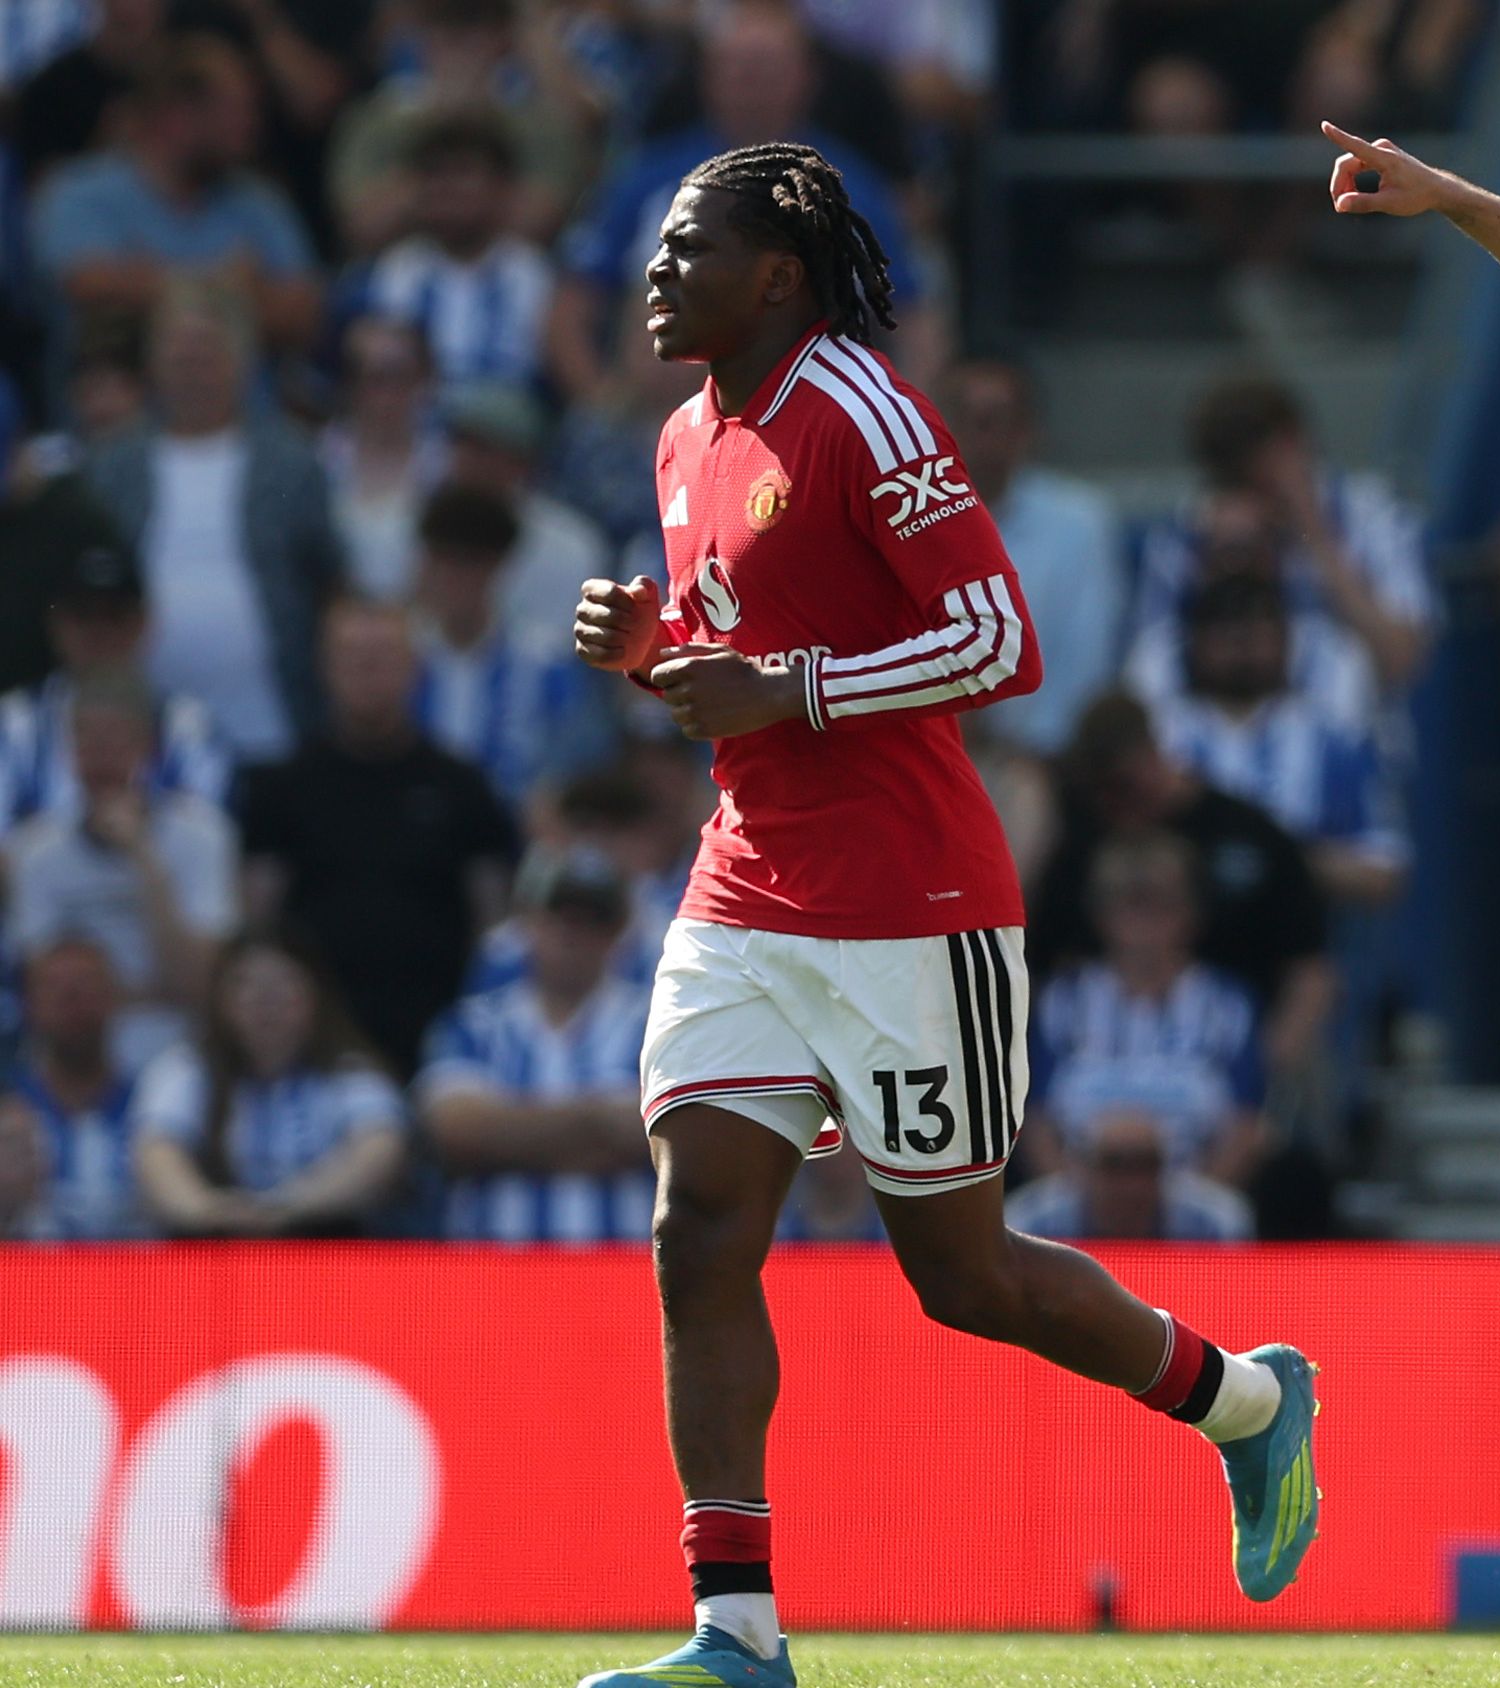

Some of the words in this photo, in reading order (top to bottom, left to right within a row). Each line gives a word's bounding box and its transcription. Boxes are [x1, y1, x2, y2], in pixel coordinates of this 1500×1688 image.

[869, 456, 970, 528] DXC
[895, 495, 979, 541] TECHNOLOGY
[872, 1065, 956, 1154] 13
